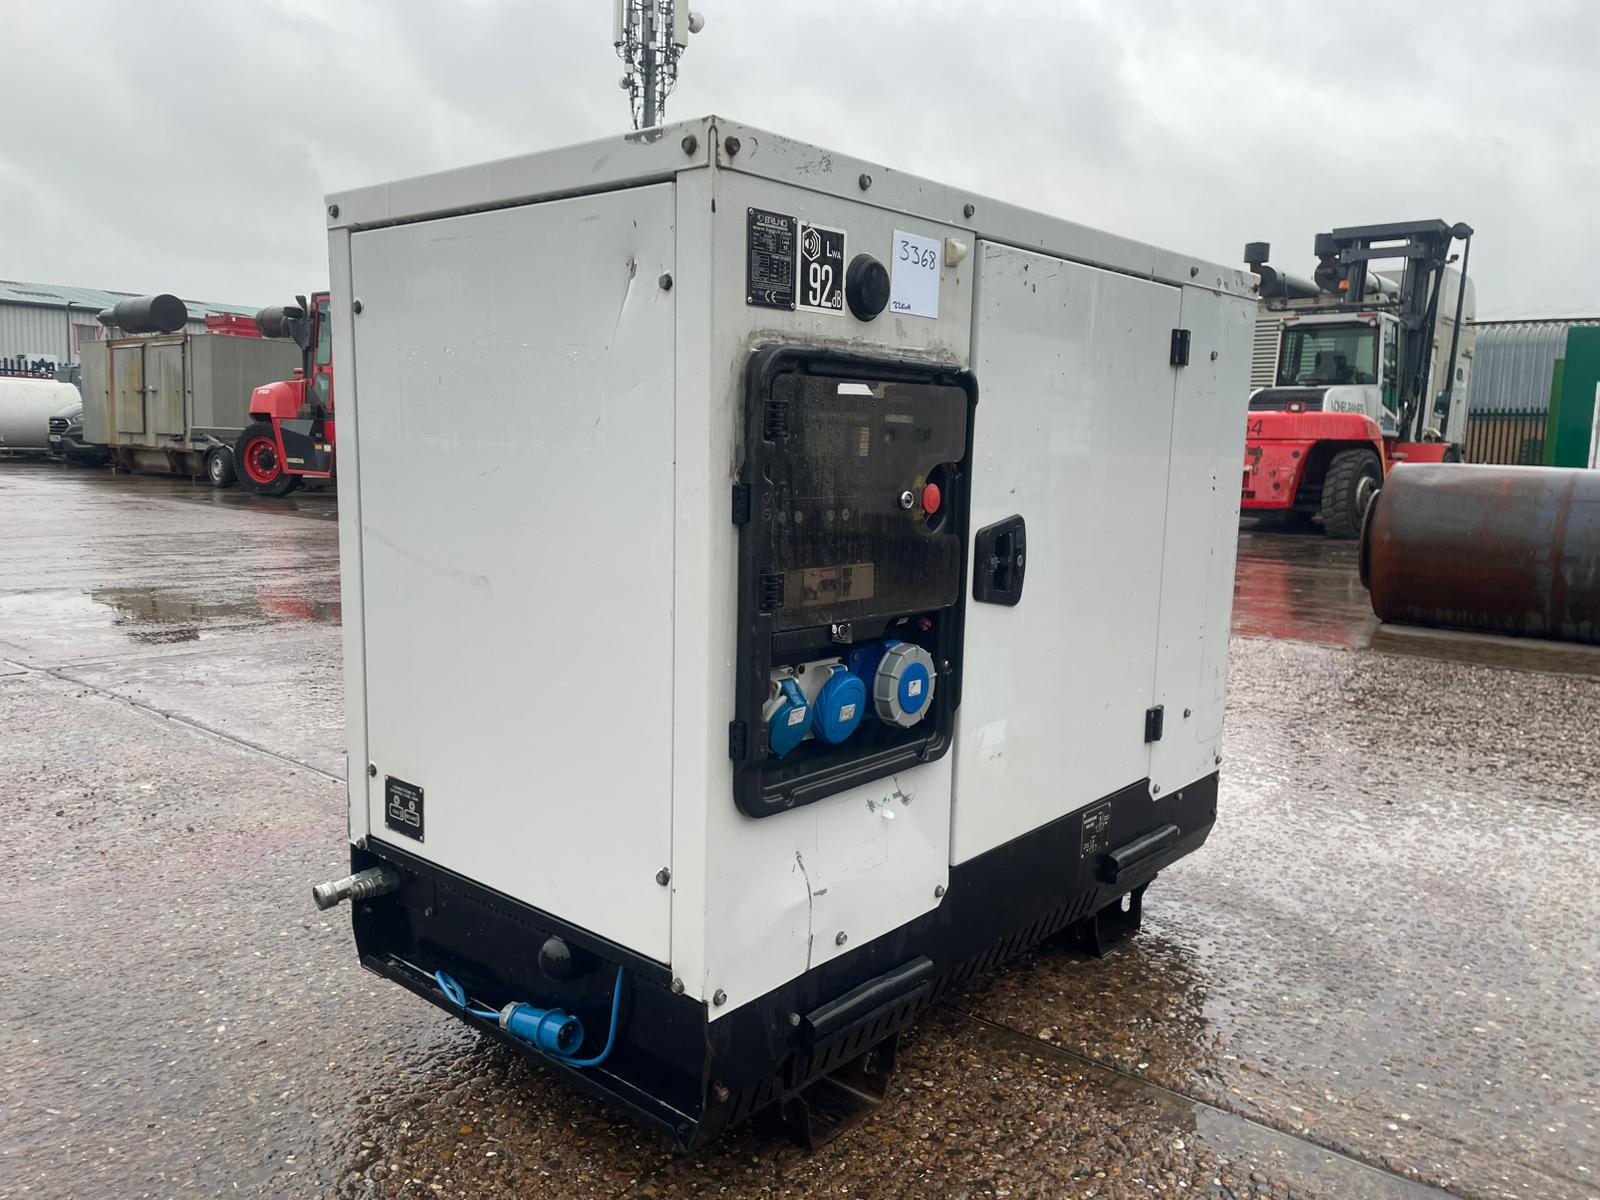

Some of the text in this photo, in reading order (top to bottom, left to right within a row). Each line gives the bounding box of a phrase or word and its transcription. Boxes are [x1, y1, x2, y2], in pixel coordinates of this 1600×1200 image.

[900, 240, 937, 271] 3368
[808, 262, 833, 308] 92
[831, 289, 842, 308] dB
